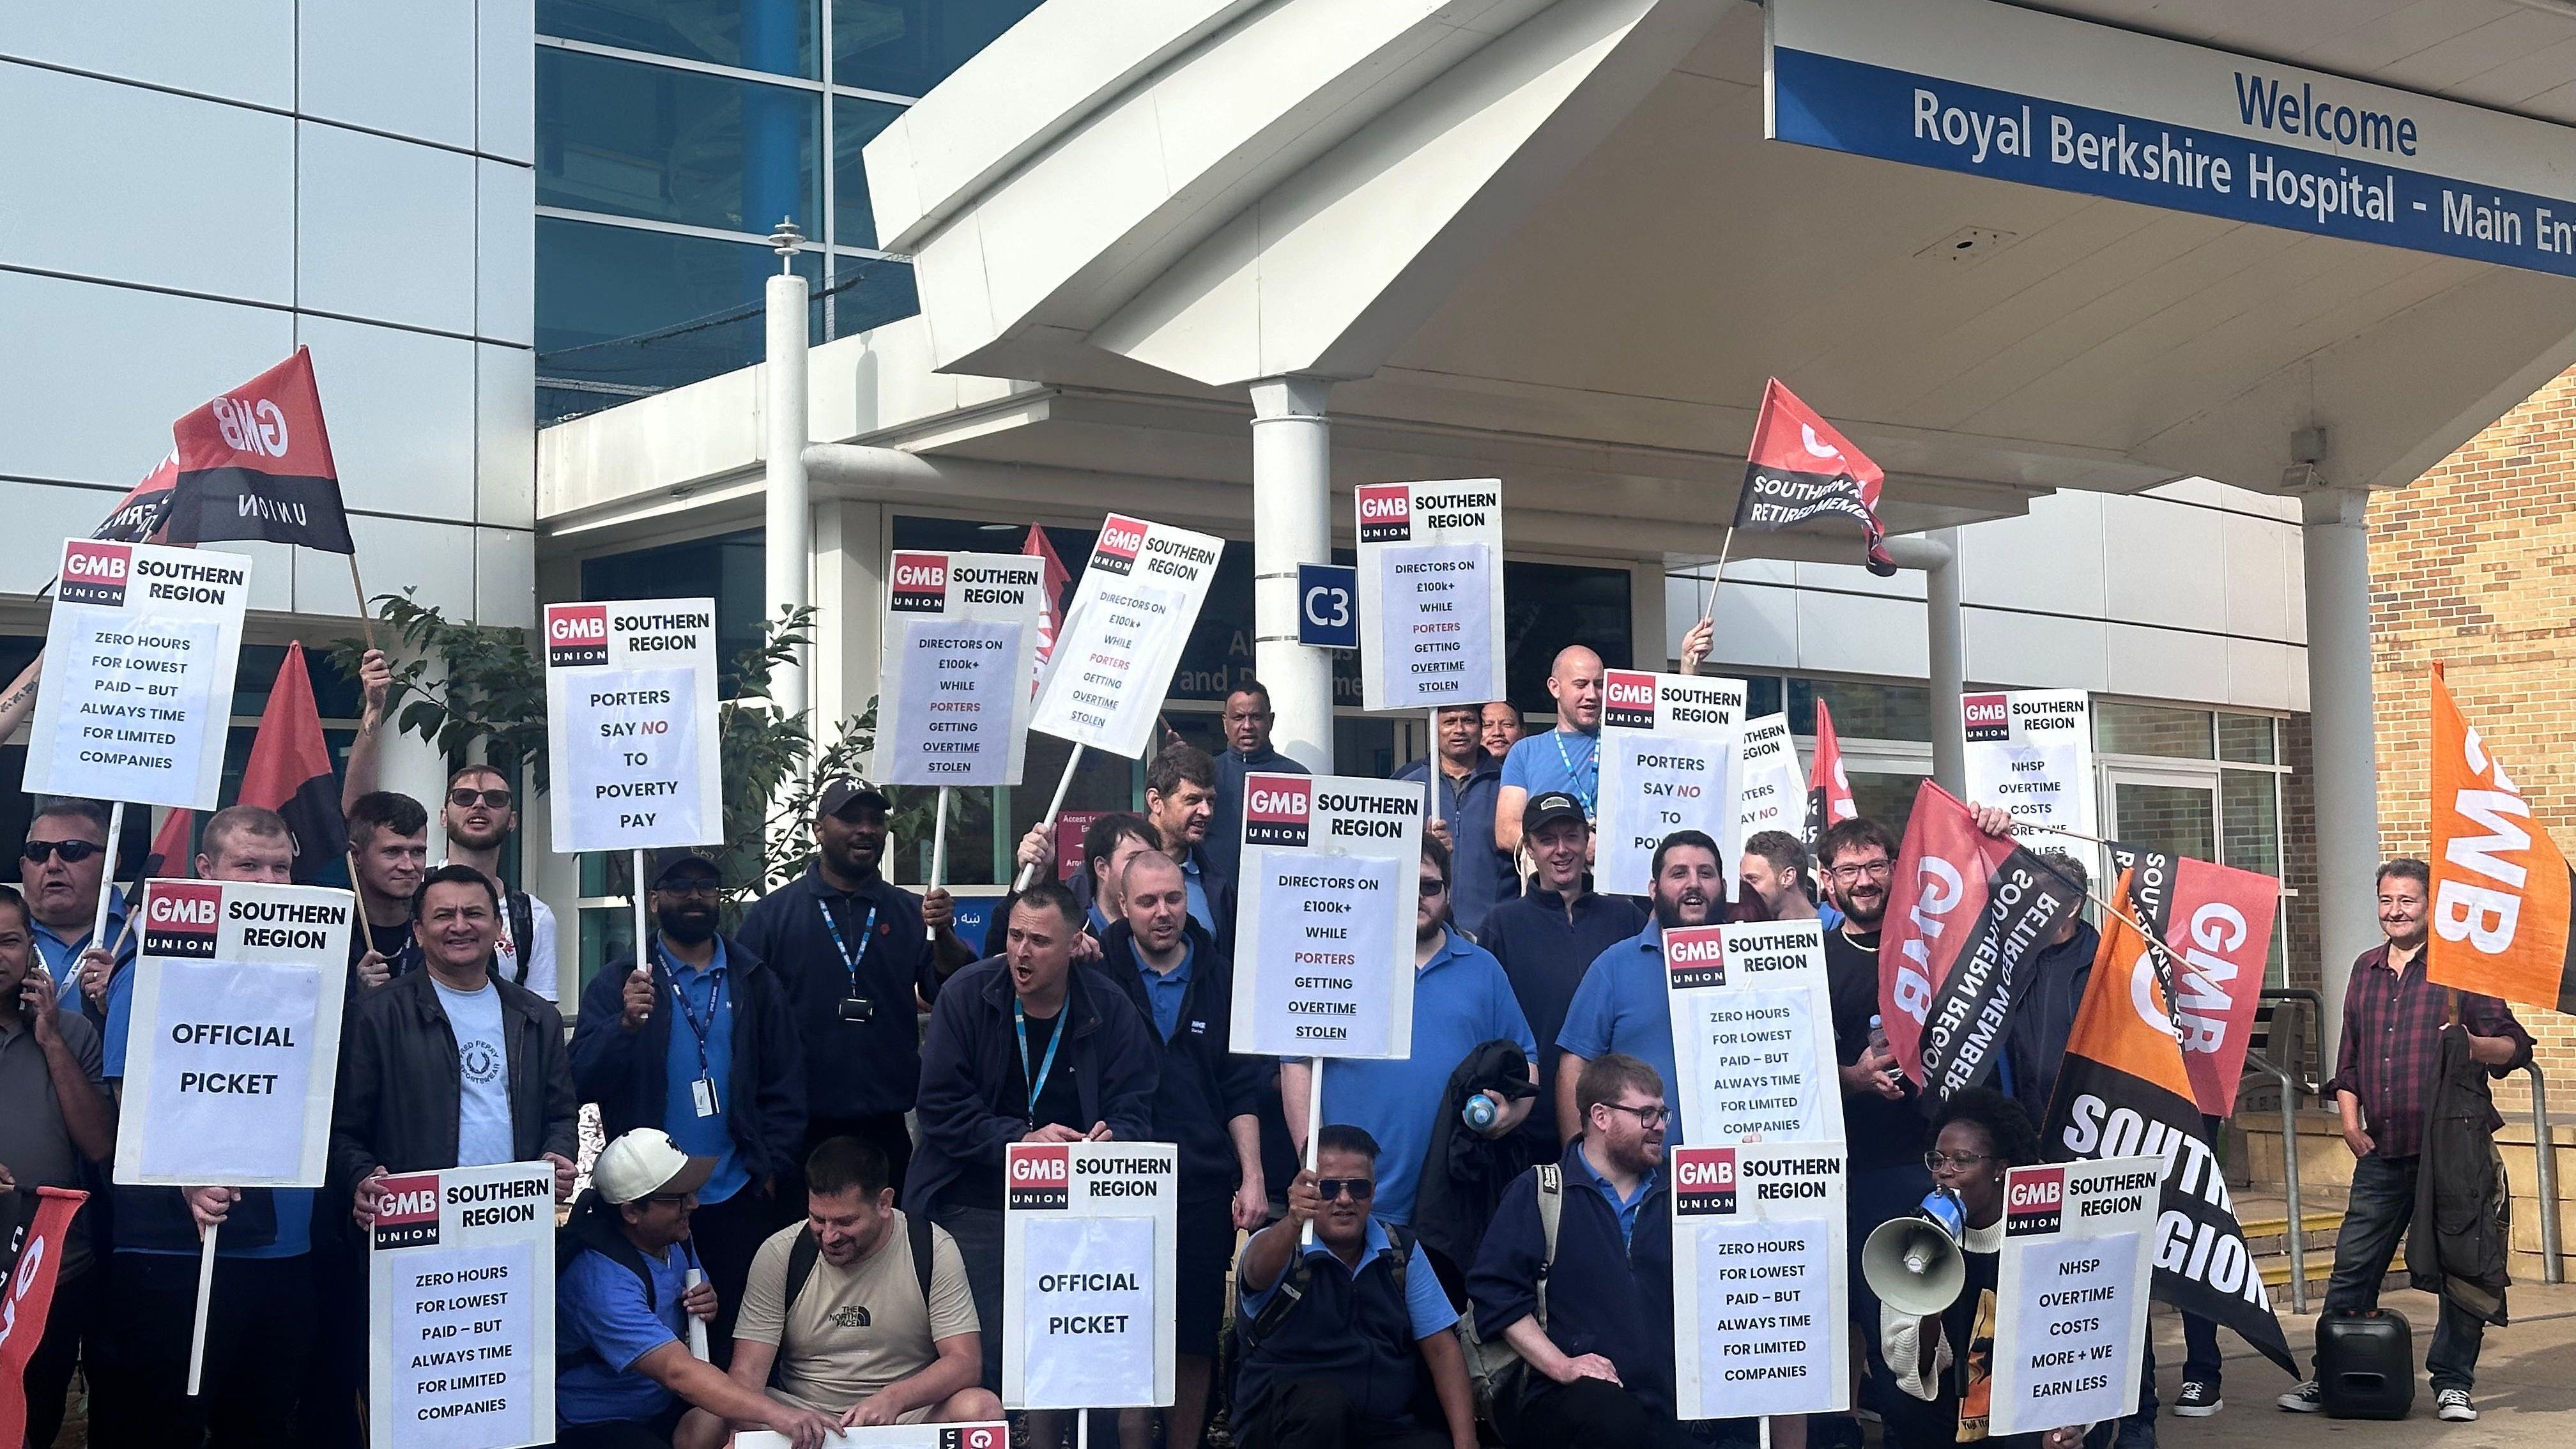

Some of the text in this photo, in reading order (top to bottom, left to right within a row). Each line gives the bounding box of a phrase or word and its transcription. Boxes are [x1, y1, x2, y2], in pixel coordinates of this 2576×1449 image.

[2234, 71, 2418, 157] Welcome
[1914, 88, 2576, 255] Royal Berkshire Hospital Main En
[1362, 498, 1407, 517] GMB
[1416, 493, 1496, 510] SOUTHERN
[1429, 513, 1484, 528] REGION
[1751, 503, 1817, 523] RETIRED
[1103, 528, 1140, 551] GMB
[68, 555, 125, 578] GMB
[137, 560, 243, 585] SOUTHERN
[1396, 561, 1474, 573] DIRECTORS ON
[1417, 582, 1454, 592] £100k+
[1100, 592, 1166, 614] DIRECTORS ON
[1306, 586, 1349, 626] C3
[1420, 602, 1452, 612] WHILE
[615, 613, 709, 631] SOUTHERN
[1109, 615, 1140, 627] £100k+
[1413, 623, 1460, 634] PORTERS
[95, 632, 190, 650] ZERO HOURS
[919, 639, 1002, 649] DIRECTORS ON
[1105, 634, 1131, 648] WHILE
[1415, 642, 1460, 652] GETTING
[92, 656, 188, 673] FOR LOWEST
[939, 659, 979, 669] £100k+
[1090, 654, 1130, 670] PORTERS
[1411, 661, 1464, 673] OVERTIME
[940, 681, 974, 690] WHILE
[1084, 673, 1122, 689] GETTING
[1180, 664, 1227, 691] and
[95, 680, 178, 696] PAID BUT
[1419, 681, 1458, 691] STOLEN
[591, 691, 670, 707] PORTERS
[1073, 691, 1119, 709] OVERTIME
[1661, 688, 1741, 707] SOUTHERN
[80, 703, 185, 721] ALWAYS TIME
[930, 703, 980, 712] PORTERS
[2013, 701, 2083, 714] SOUTHERN
[930, 723, 977, 732] GETTING
[1071, 711, 1105, 728] STOLEN
[2025, 717, 2074, 730] REGION
[84, 727, 175, 744] FOR LIMITED
[601, 721, 668, 737] SAY NO
[923, 742, 980, 753] OVERTIME
[80, 751, 172, 769] COMPANIES
[624, 753, 647, 766] TO
[928, 763, 970, 771] STOLEN
[1637, 755, 1704, 770] PORTERS
[2012, 762, 2044, 771] NHSP
[596, 781, 678, 799] POVERTY
[1644, 783, 1700, 797] SAY NO
[1999, 782, 2060, 793] OVERTIME
[1251, 790, 1307, 815] GMB
[2011, 804, 2051, 814] COSTS
[621, 813, 656, 827] PAY
[1660, 811, 1681, 824] TO
[1759, 807, 1777, 820] NO
[1279, 876, 1378, 890] DIRECTORS ON
[151, 898, 215, 923] GMB
[229, 901, 346, 924] SOUTHERN
[1304, 901, 1351, 913] £100k+
[1306, 927, 1347, 939] WHILE
[1295, 953, 1354, 965] PORTERS
[1295, 977, 1353, 989] GETTING
[2177, 902, 2247, 1054] GMB
[1289, 1001, 1356, 1014] OVERTIME
[1710, 1008, 1790, 1022] ZERO HOURS
[172, 1024, 294, 1046] OFFICIAL
[1296, 1026, 1346, 1038] STOLEN
[1713, 1030, 1791, 1045] FOR LOWEST
[1721, 1053, 1789, 1066] PAID BUT
[181, 1073, 278, 1094] PICKET
[1714, 1075, 1800, 1089] ALWAYS TIME
[1721, 1098, 1797, 1111] FOR LIMITED
[1724, 1120, 1800, 1133] COMPANIES
[1744, 1158, 1839, 1177] SOUTHERN
[447, 1179, 548, 1204] SOUTHERN
[2070, 1172, 2156, 1195] SOUTHERN
[2011, 1182, 2060, 1206] GMB
[1719, 1240, 1804, 1255] ZERO HOURS
[1720, 1265, 1805, 1280] FOR LOWEST
[2059, 1259, 2099, 1275] NHSP
[416, 1266, 507, 1287] ZERO HOURS
[1039, 1273, 1139, 1292] OFFICIAL
[417, 1292, 508, 1314] FOR LOWEST
[1727, 1291, 1800, 1305] PAID BUT
[2039, 1286, 2114, 1307] OVERTIME
[422, 1319, 502, 1340] PAID BUT
[1050, 1315, 1128, 1334] PICKET
[1718, 1315, 1811, 1331] ALWAYS TIME
[2050, 1318, 2099, 1335] COSTS
[411, 1345, 512, 1368] ALWAYS TIME
[1724, 1341, 1805, 1356] FOR LIMITED
[2032, 1345, 2112, 1368] MORE WE
[1725, 1366, 1806, 1381] COMPANIES
[418, 1372, 506, 1394] FOR LIMITED
[2033, 1375, 2107, 1397] EARN LESS
[418, 1399, 505, 1420] COMPANIES
